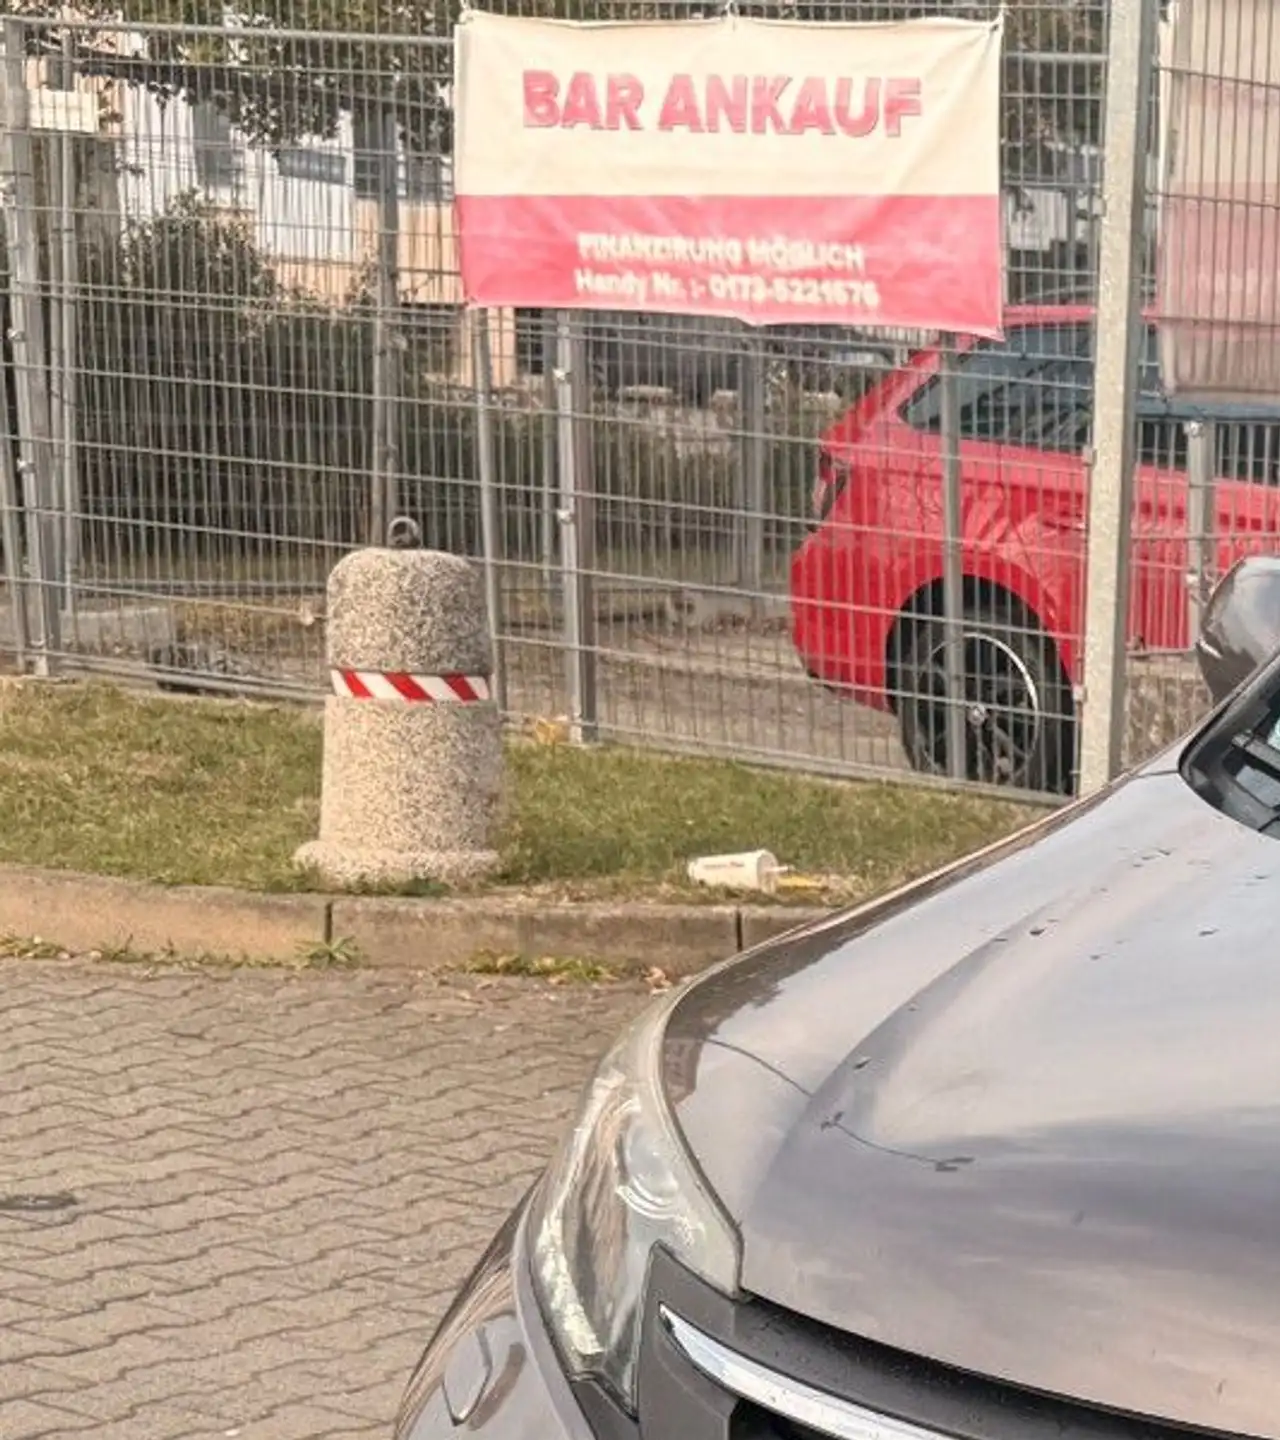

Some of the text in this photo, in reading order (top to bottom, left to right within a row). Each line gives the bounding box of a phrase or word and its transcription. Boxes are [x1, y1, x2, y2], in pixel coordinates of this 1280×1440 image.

[521, 69, 924, 138] BAR ANKAUF
[574, 267, 648, 304] Handy
